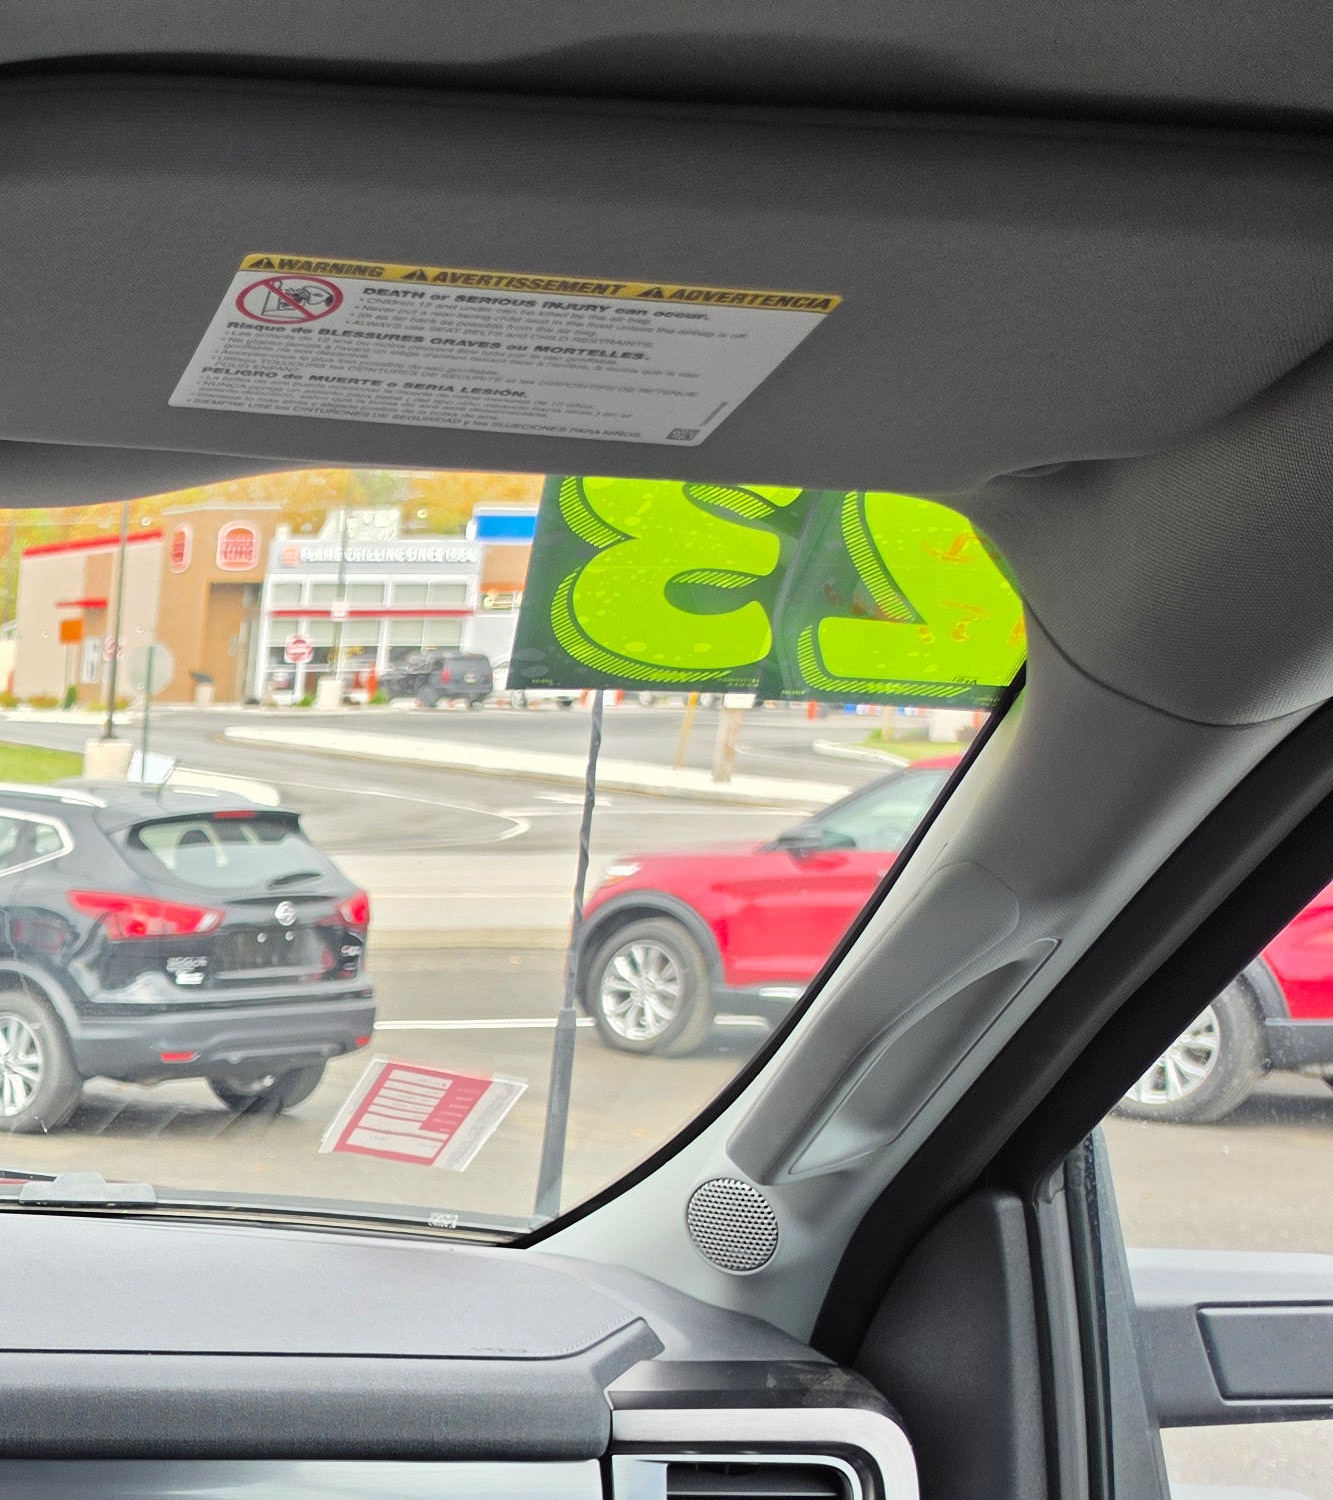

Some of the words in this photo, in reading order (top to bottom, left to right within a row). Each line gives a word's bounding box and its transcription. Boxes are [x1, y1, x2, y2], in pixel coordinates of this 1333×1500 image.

[278, 258, 386, 279] WARNING
[434, 271, 627, 296] AVERTISSEMENT
[672, 288, 834, 312] ADVERTENCIA
[363, 287, 426, 299] DEATH
[454, 294, 537, 308] SERIOUS
[542, 301, 612, 313] INJURY
[614, 308, 649, 316] can
[226, 321, 286, 333] Risque
[291, 326, 313, 335] de
[318, 328, 425, 344] BLESSURES
[430, 338, 502, 350] GRAVES
[201, 366, 278, 379] PELIGRO
[283, 371, 304, 380] de
[308, 375, 383, 387] MUERTE
[402, 381, 456, 395] SERIA
[460, 385, 528, 399] LESIÓN.
